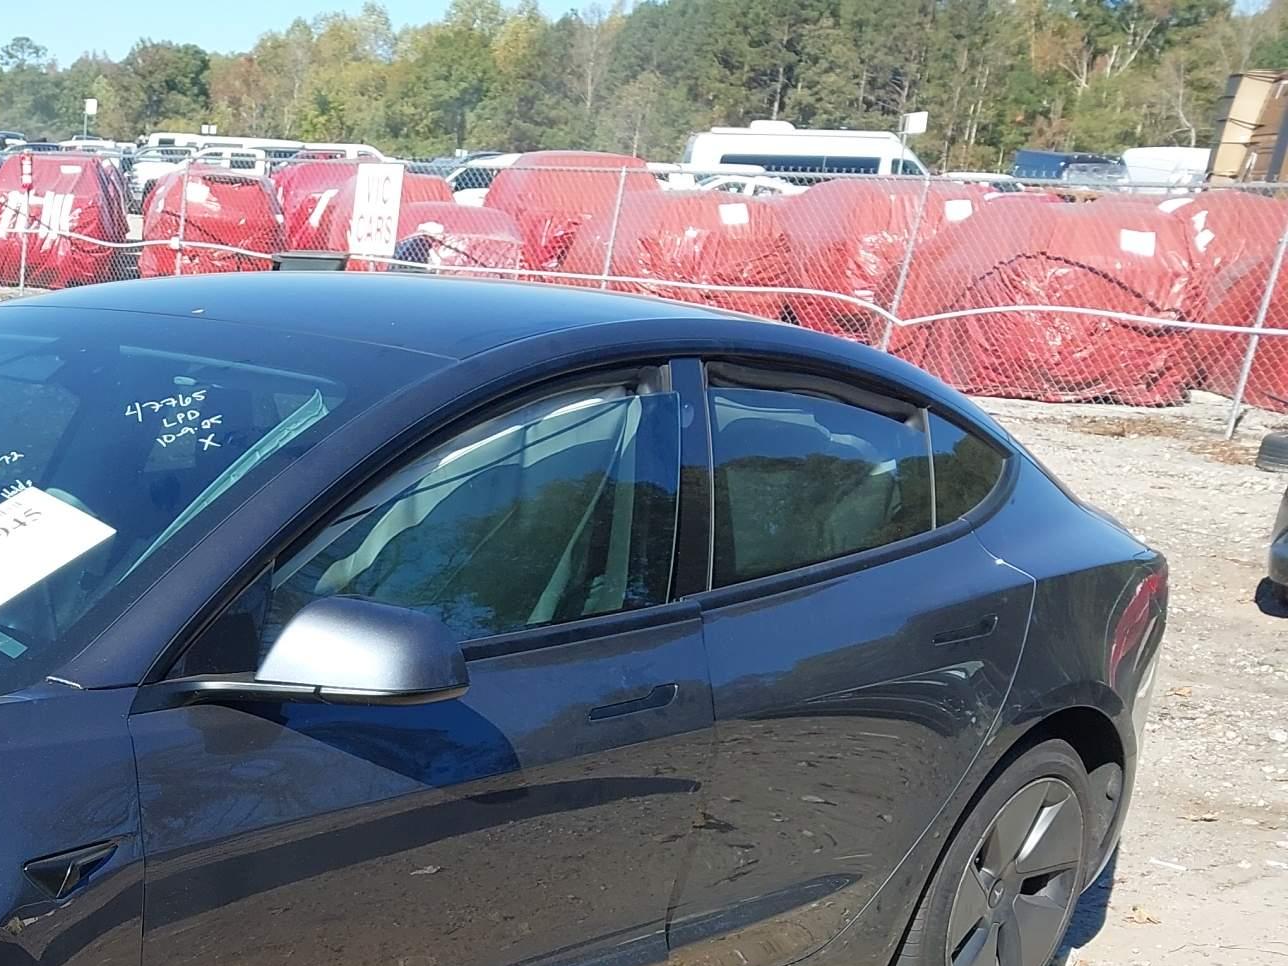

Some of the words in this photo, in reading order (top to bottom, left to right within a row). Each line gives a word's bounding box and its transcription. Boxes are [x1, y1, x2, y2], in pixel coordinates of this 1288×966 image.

[356, 214, 393, 244] CARS
[162, 409, 200, 428] LPD
[198, 433, 221, 450] X
